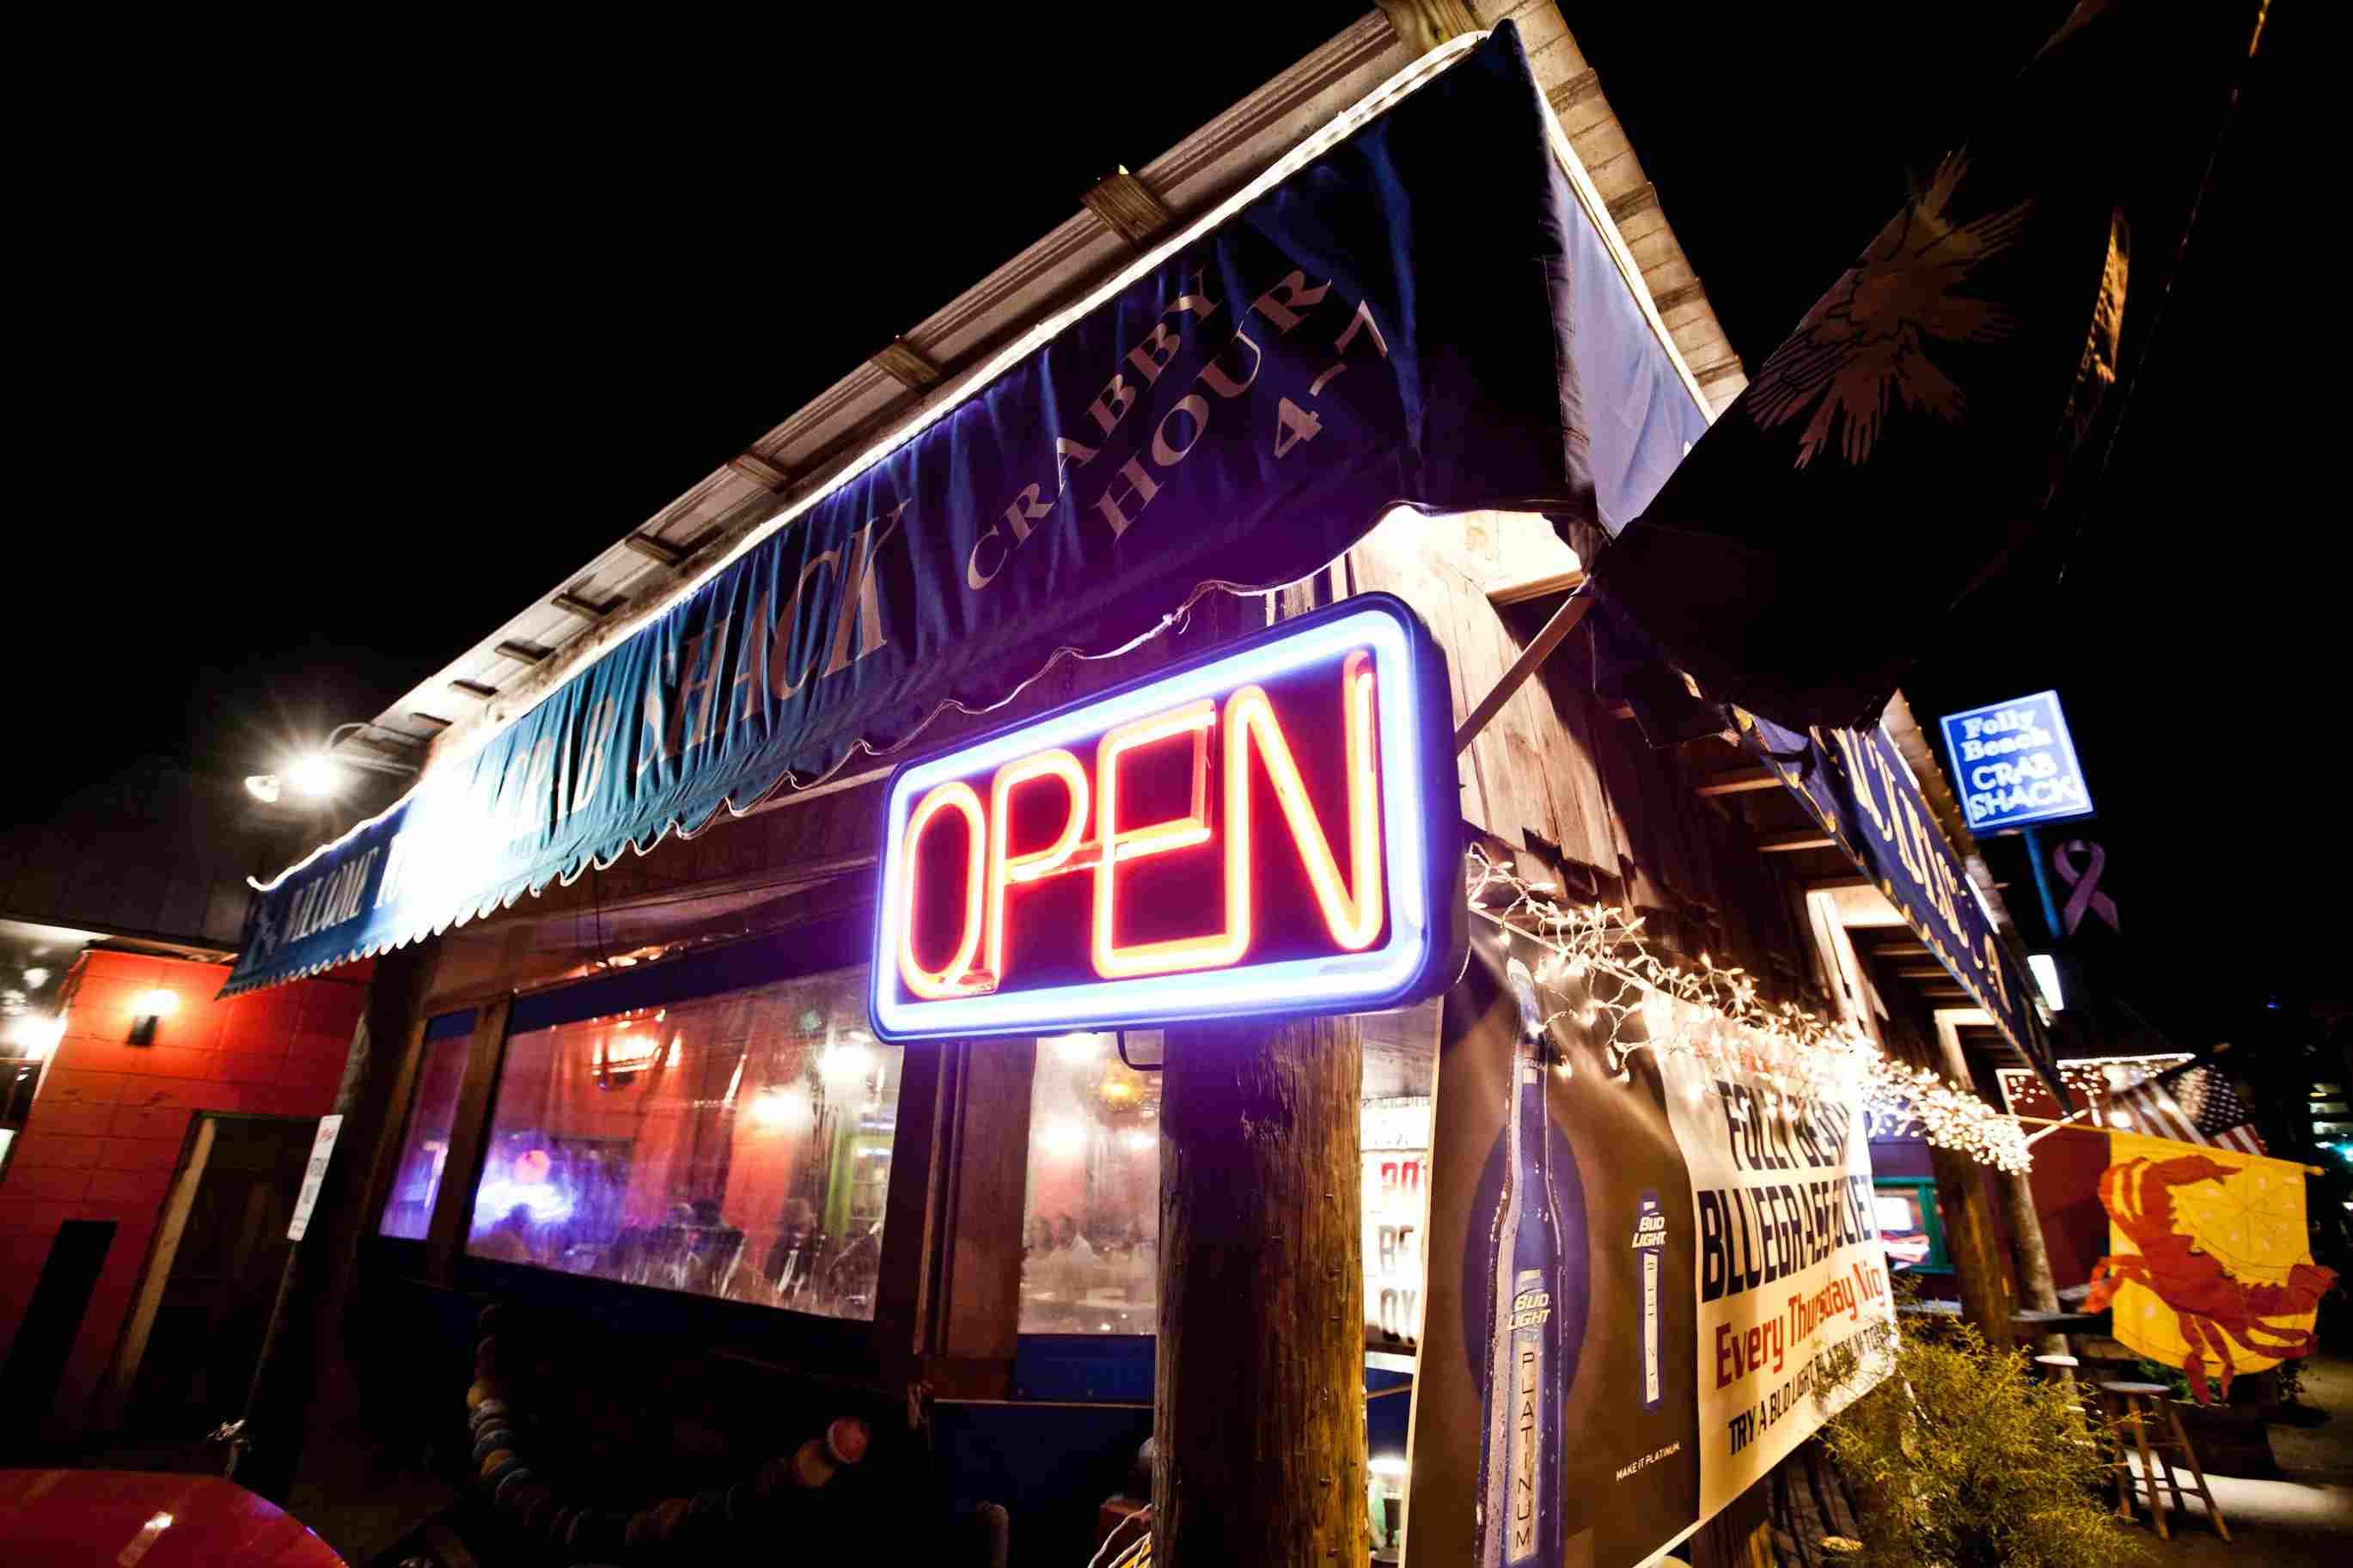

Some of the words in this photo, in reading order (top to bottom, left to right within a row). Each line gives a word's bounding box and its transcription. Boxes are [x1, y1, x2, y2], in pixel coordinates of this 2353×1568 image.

[968, 265, 1222, 590] CRABBY
[1092, 269, 1332, 545] HOUR
[636, 497, 912, 774] SHACK
[1959, 727, 2054, 762] Beach
[1960, 709, 2036, 740] Folly
[1971, 752, 2058, 790] CRAB
[1968, 774, 2082, 822] SHACK
[897, 647, 1384, 1000] OPEN
[1632, 1230, 1666, 1248] LIGHT
[1638, 1216, 1665, 1233] BUD
[1697, 1181, 1830, 1303] BLUEGRASS
[1506, 1309, 1551, 1333] LIGHT
[1514, 1293, 1550, 1313] BUD
[1715, 1315, 1784, 1390] Every
[1788, 1273, 1858, 1348] Thursday
[1515, 1351, 1535, 1547] PLATINUM
[1728, 1402, 1757, 1455] TRY
[1757, 1400, 1767, 1437] A
[1616, 1461, 1637, 1482] MAKE
[1637, 1457, 1645, 1470] IT
